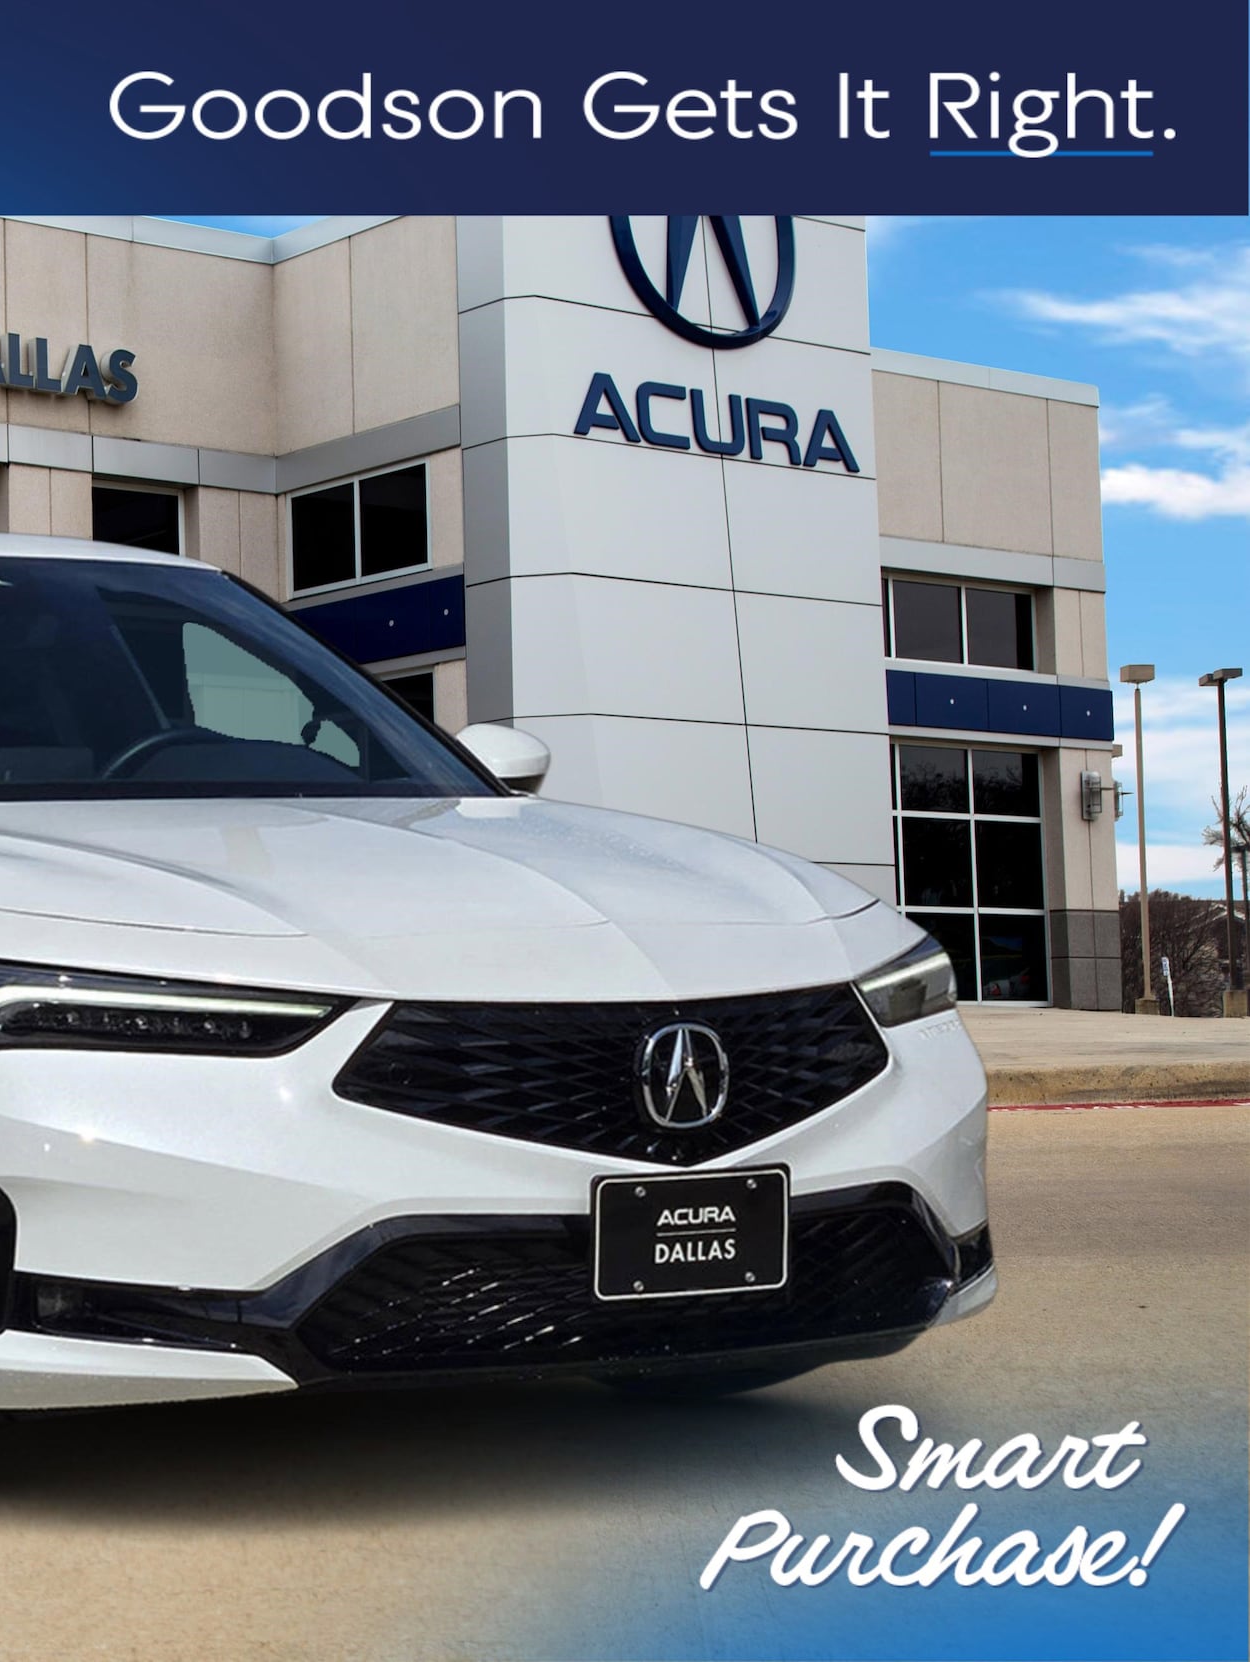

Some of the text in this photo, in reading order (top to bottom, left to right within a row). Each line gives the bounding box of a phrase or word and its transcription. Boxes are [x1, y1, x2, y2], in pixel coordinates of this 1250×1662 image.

[573, 371, 860, 474] ACURA
[657, 1205, 736, 1227] ACURA
[655, 1238, 736, 1264] DALLAS
